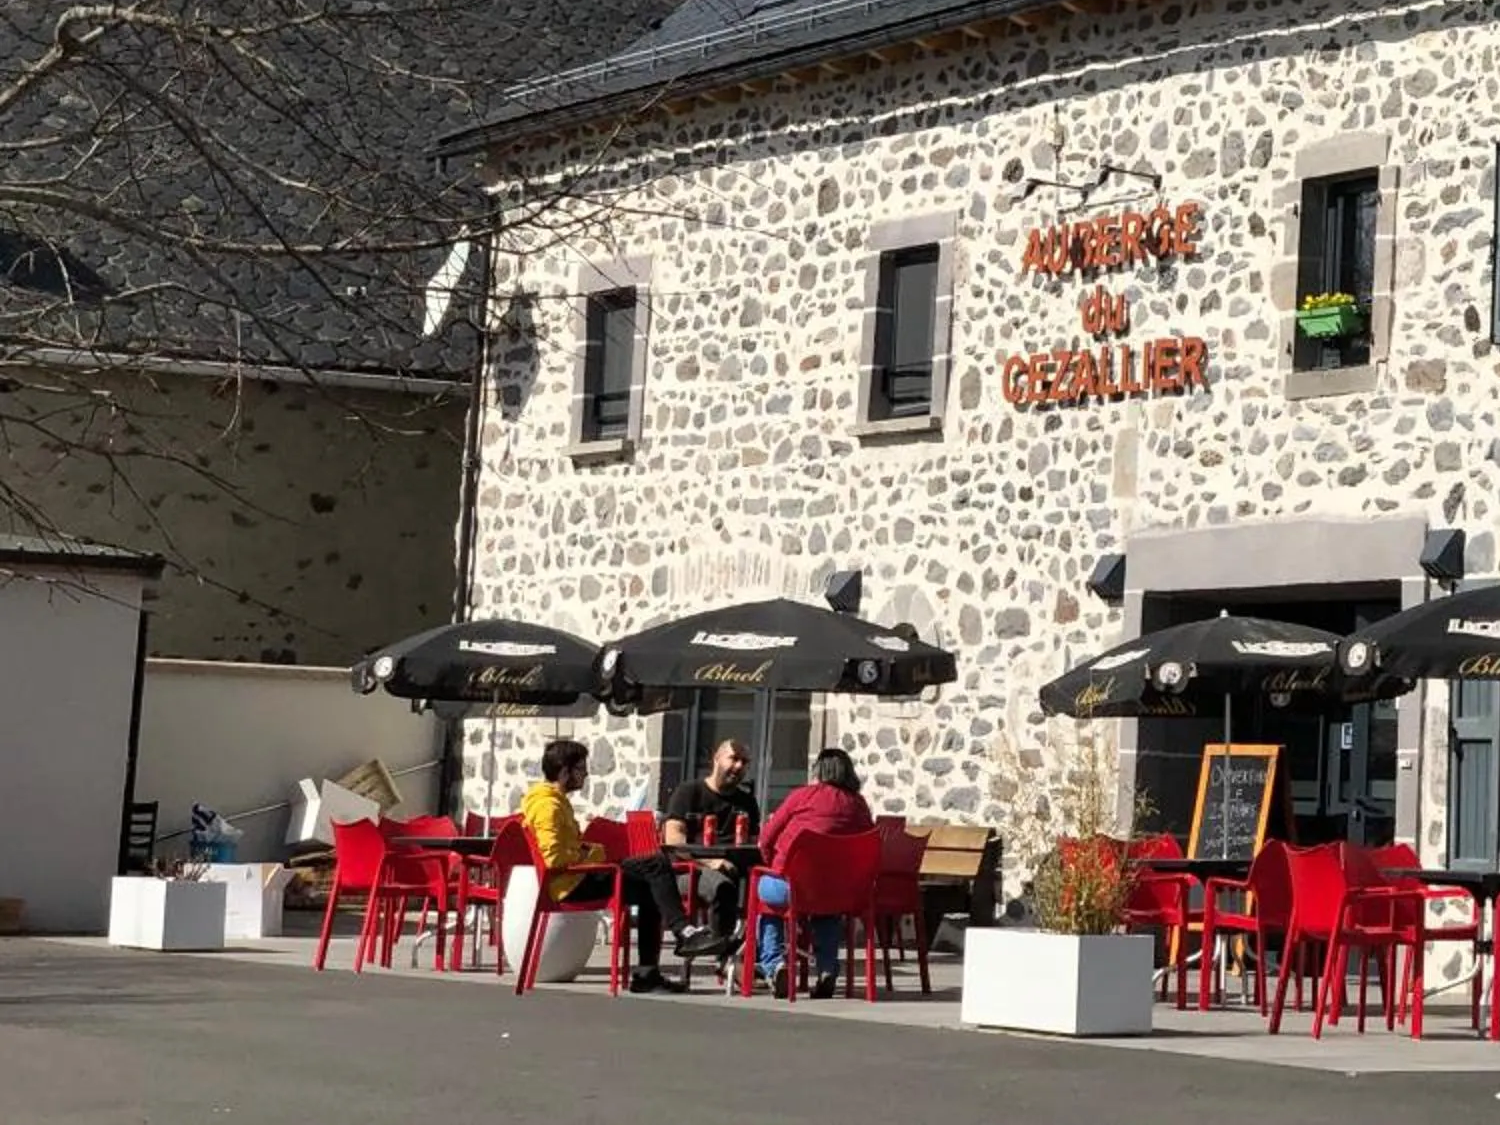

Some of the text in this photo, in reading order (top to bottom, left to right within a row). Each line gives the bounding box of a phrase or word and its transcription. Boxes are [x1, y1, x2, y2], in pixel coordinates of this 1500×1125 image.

[1020, 203, 1199, 276] AUBERGE
[1081, 285, 1130, 333] du
[1002, 336, 1208, 404] CEZALLIER
[694, 658, 774, 682] Black
